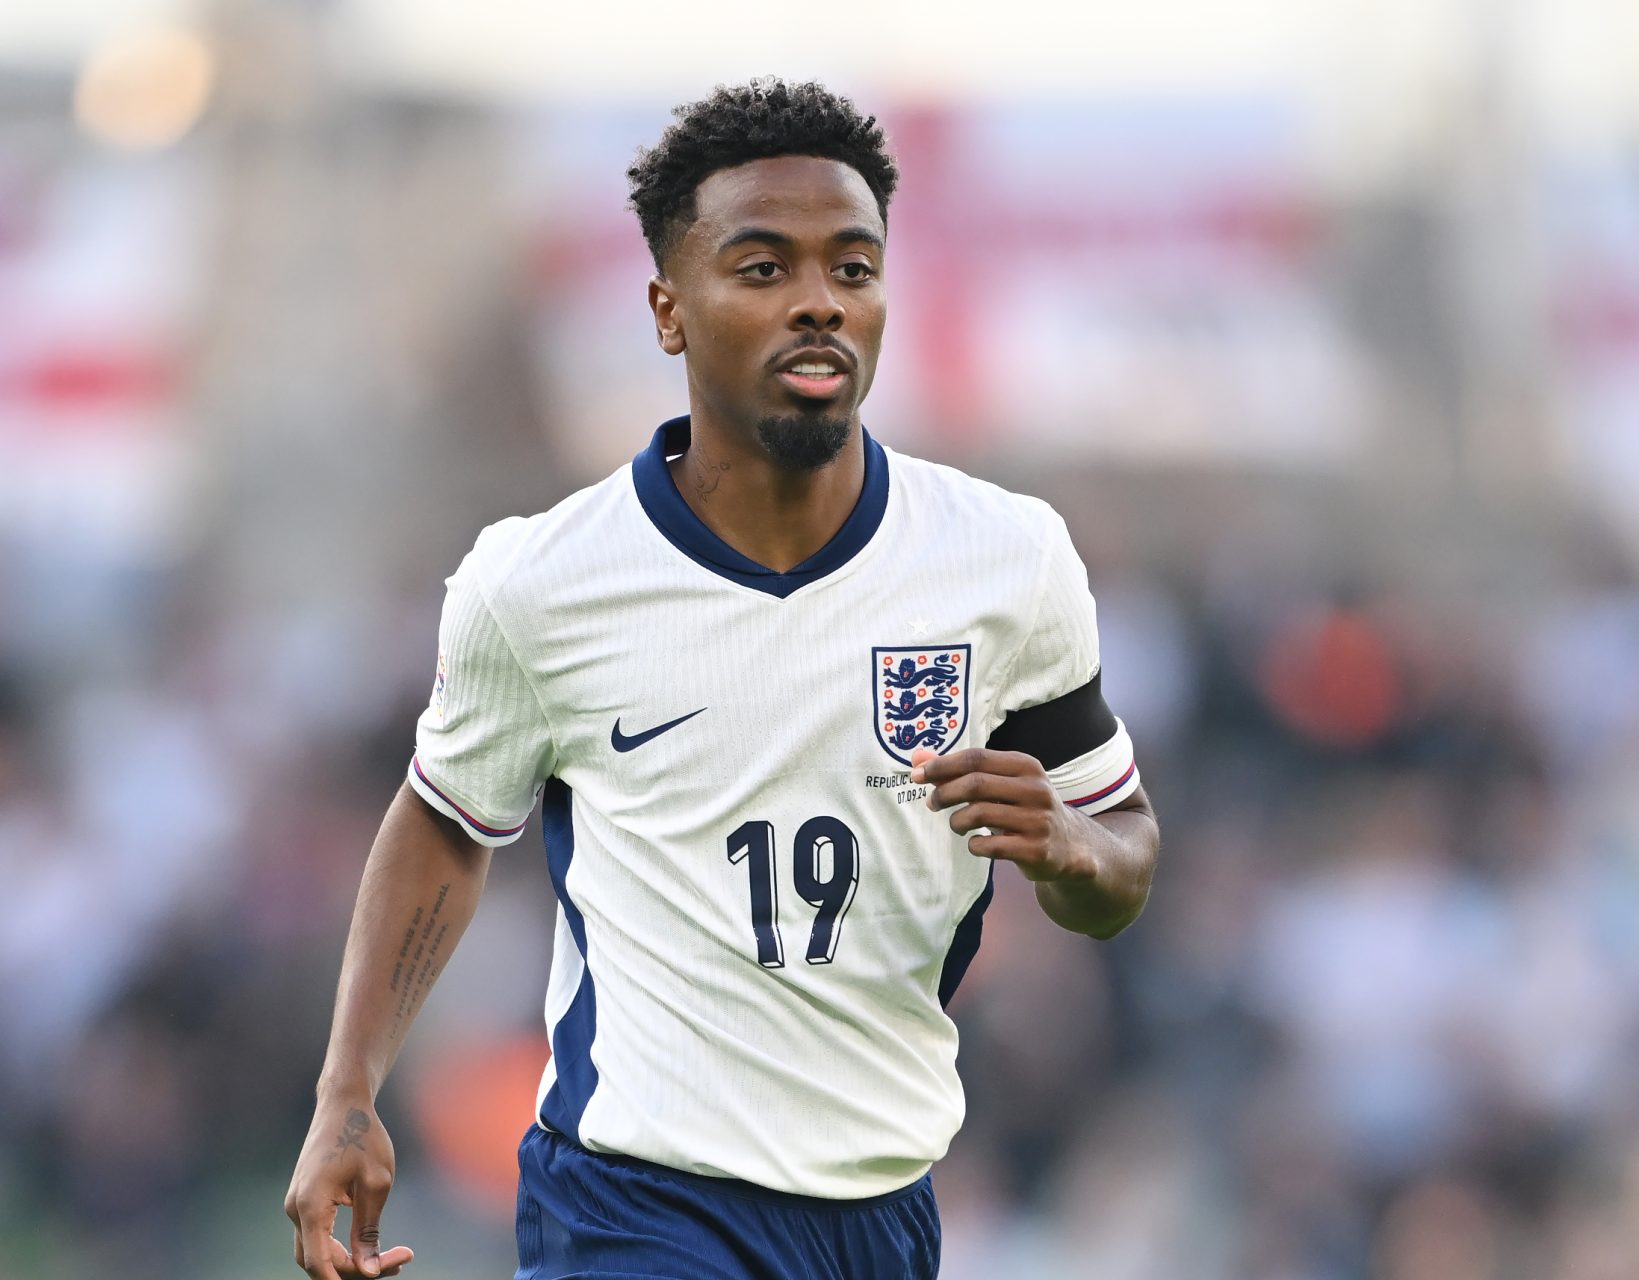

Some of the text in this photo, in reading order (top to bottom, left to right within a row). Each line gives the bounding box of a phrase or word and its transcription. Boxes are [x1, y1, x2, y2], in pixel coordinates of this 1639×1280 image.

[866, 775, 908, 789] REPUBLIC
[897, 786, 927, 804] 07.09.24
[727, 816, 860, 968] 19
